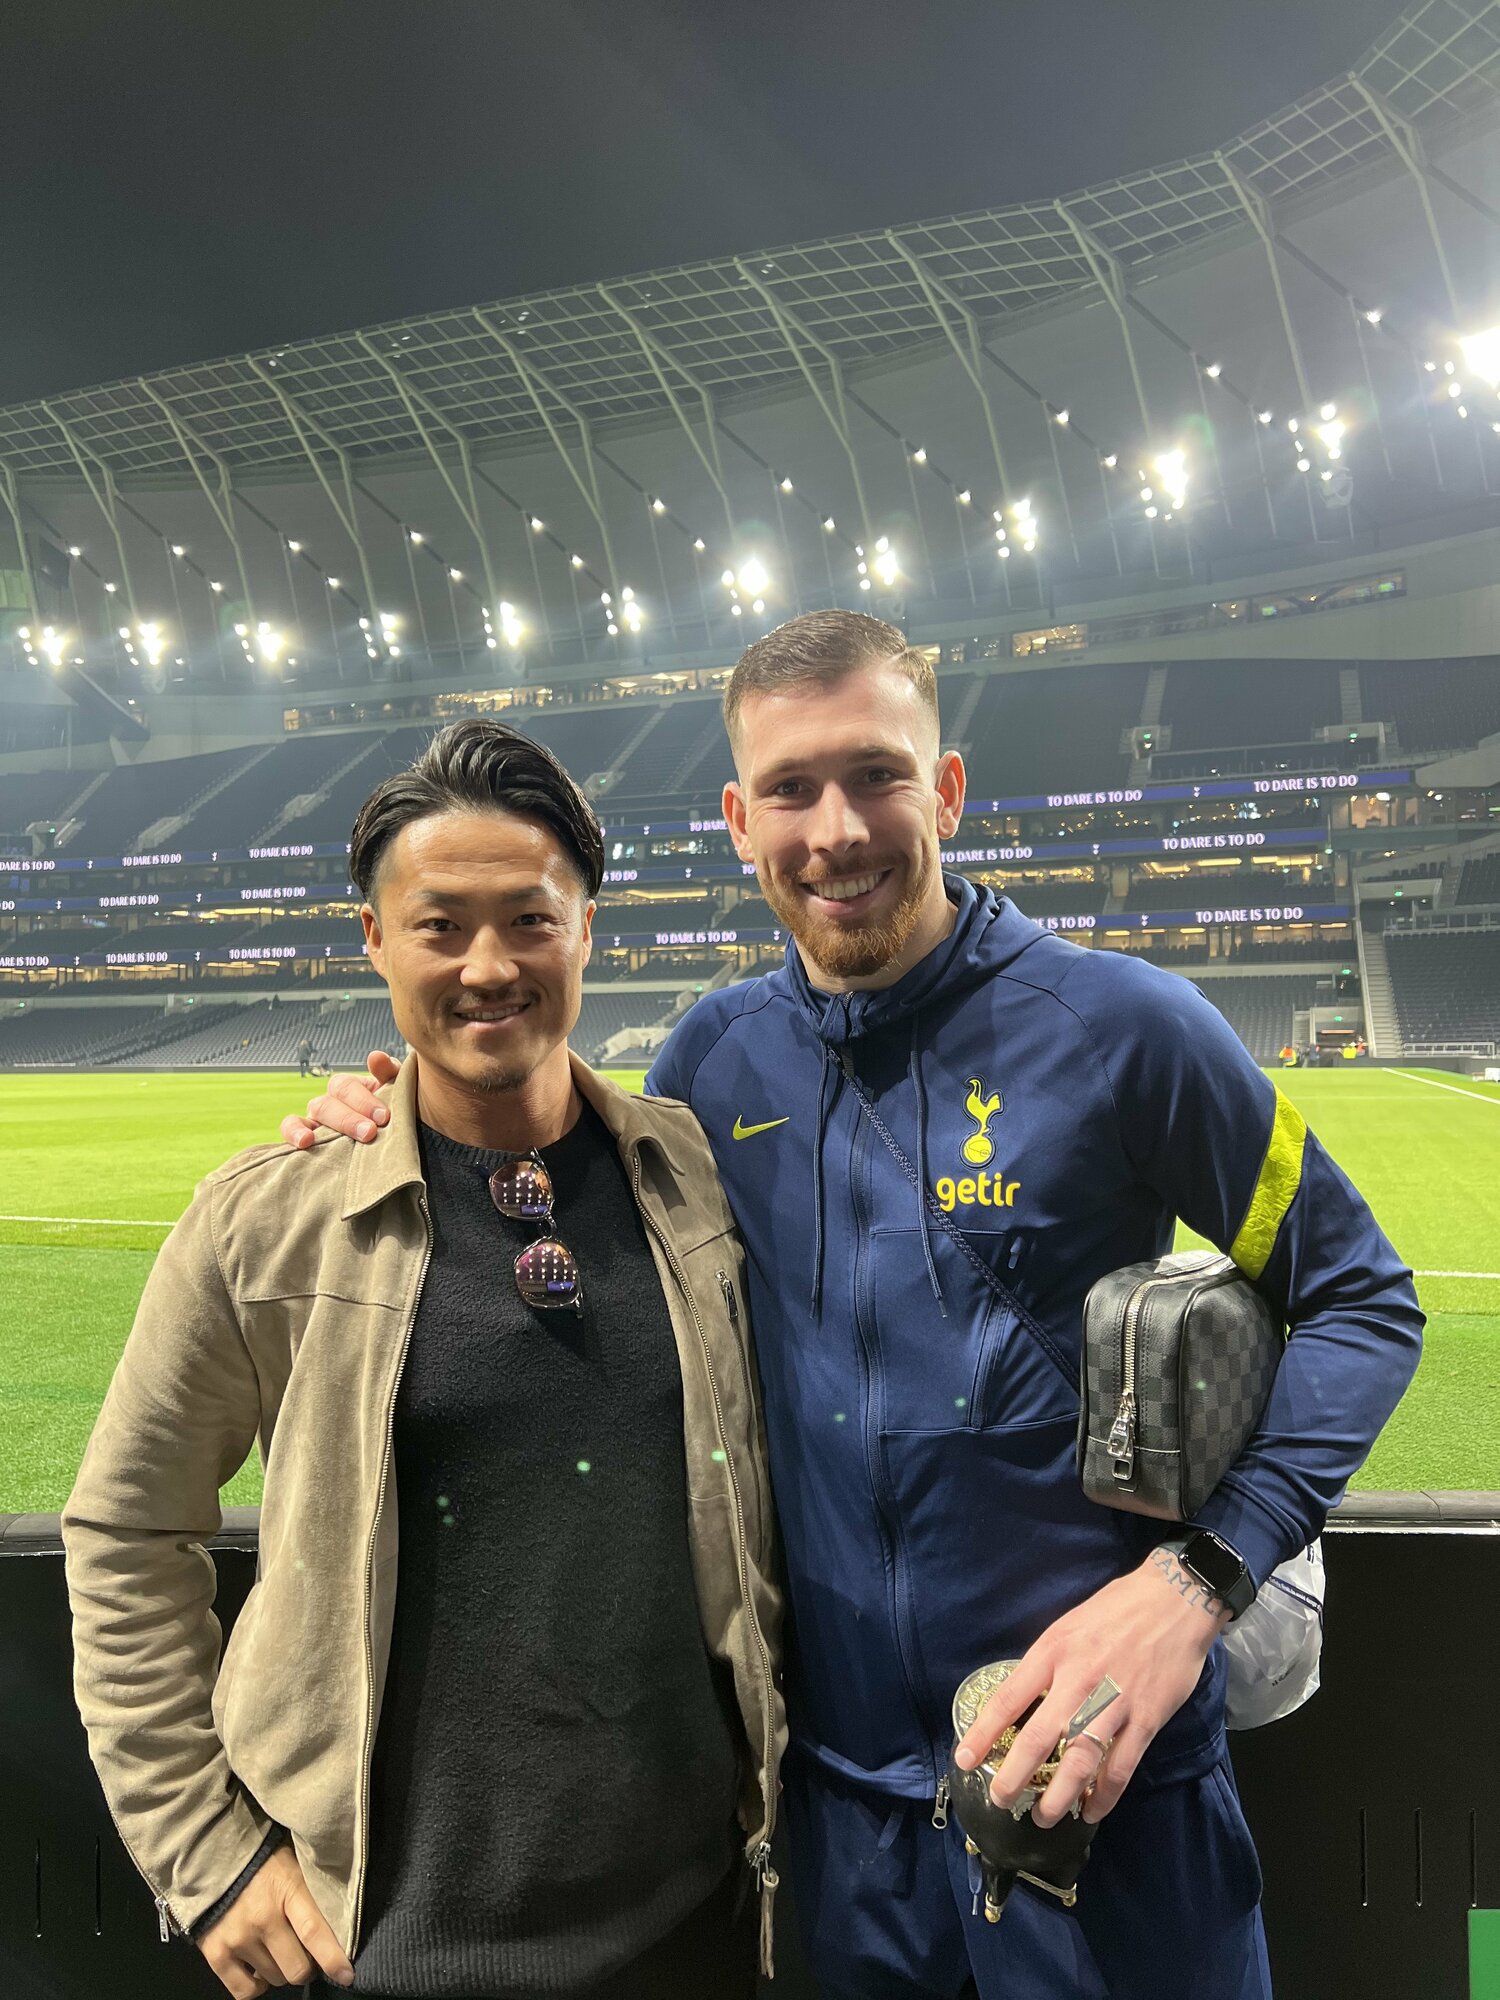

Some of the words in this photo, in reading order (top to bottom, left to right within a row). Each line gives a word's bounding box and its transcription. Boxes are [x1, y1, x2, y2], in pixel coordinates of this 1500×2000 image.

[1254, 781, 1271, 792] TO
[1272, 778, 1304, 791] DARE
[1306, 777, 1319, 789] IS
[1320, 776, 1336, 788] TO
[1338, 775, 1358, 787] DO
[1047, 795, 1062, 807] TO
[1064, 793, 1094, 806] DARE
[1095, 792, 1106, 803] IS
[1107, 791, 1123, 802] TO
[1125, 790, 1142, 801] DO
[689, 820, 702, 831] TO
[1162, 838, 1179, 849] TO
[1180, 836, 1213, 849] DARE
[1214, 835, 1226, 847] IS
[1227, 834, 1245, 846] TO
[1246, 833, 1265, 845] DO
[940, 851, 955, 863] TO
[956, 850, 985, 862] DARE
[987, 849, 998, 860] IS
[999, 848, 1013, 859] TO
[1012, 847, 1032, 858] DO
[610, 871, 622, 881] TO
[623, 871, 637, 881] DO
[1047, 917, 1058, 929] IS
[1060, 916, 1076, 928] TO
[1077, 916, 1096, 928] DO
[1195, 911, 1213, 923] TO
[1214, 909, 1248, 922] DARE
[1250, 909, 1263, 921] IS
[1264, 908, 1282, 919] TO
[1283, 907, 1303, 919] DO
[655, 933, 670, 944] TO
[669, 932, 695, 944] DARE
[696, 932, 706, 943] IS
[707, 931, 720, 942] TO
[721, 931, 737, 942] DO
[0, 958, 16, 966] ARE
[936, 1171, 1021, 1212] getir
